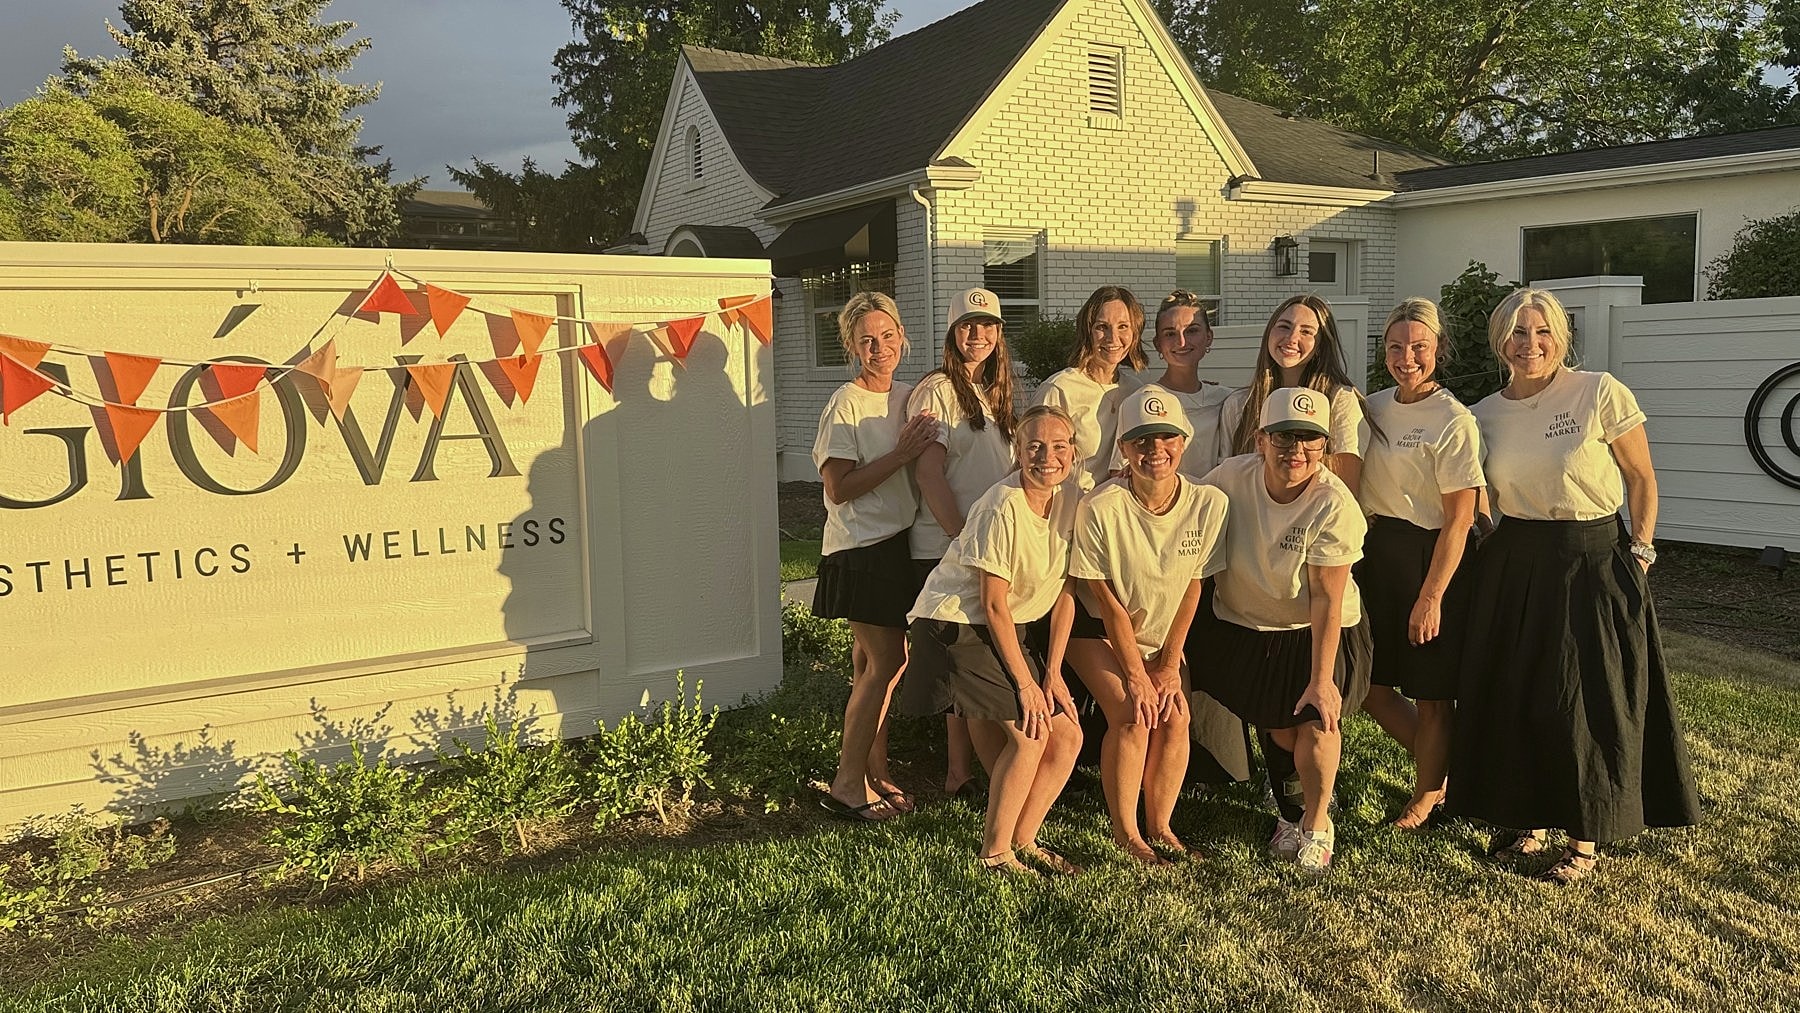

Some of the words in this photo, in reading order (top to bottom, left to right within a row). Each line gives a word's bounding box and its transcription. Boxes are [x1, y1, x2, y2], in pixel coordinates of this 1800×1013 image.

[1554, 411, 1571, 421] THE
[1545, 426, 1581, 439] MARKET
[1397, 440, 1420, 448] MARKET
[1185, 529, 1203, 538] THE
[343, 518, 566, 562] WELLNESS
